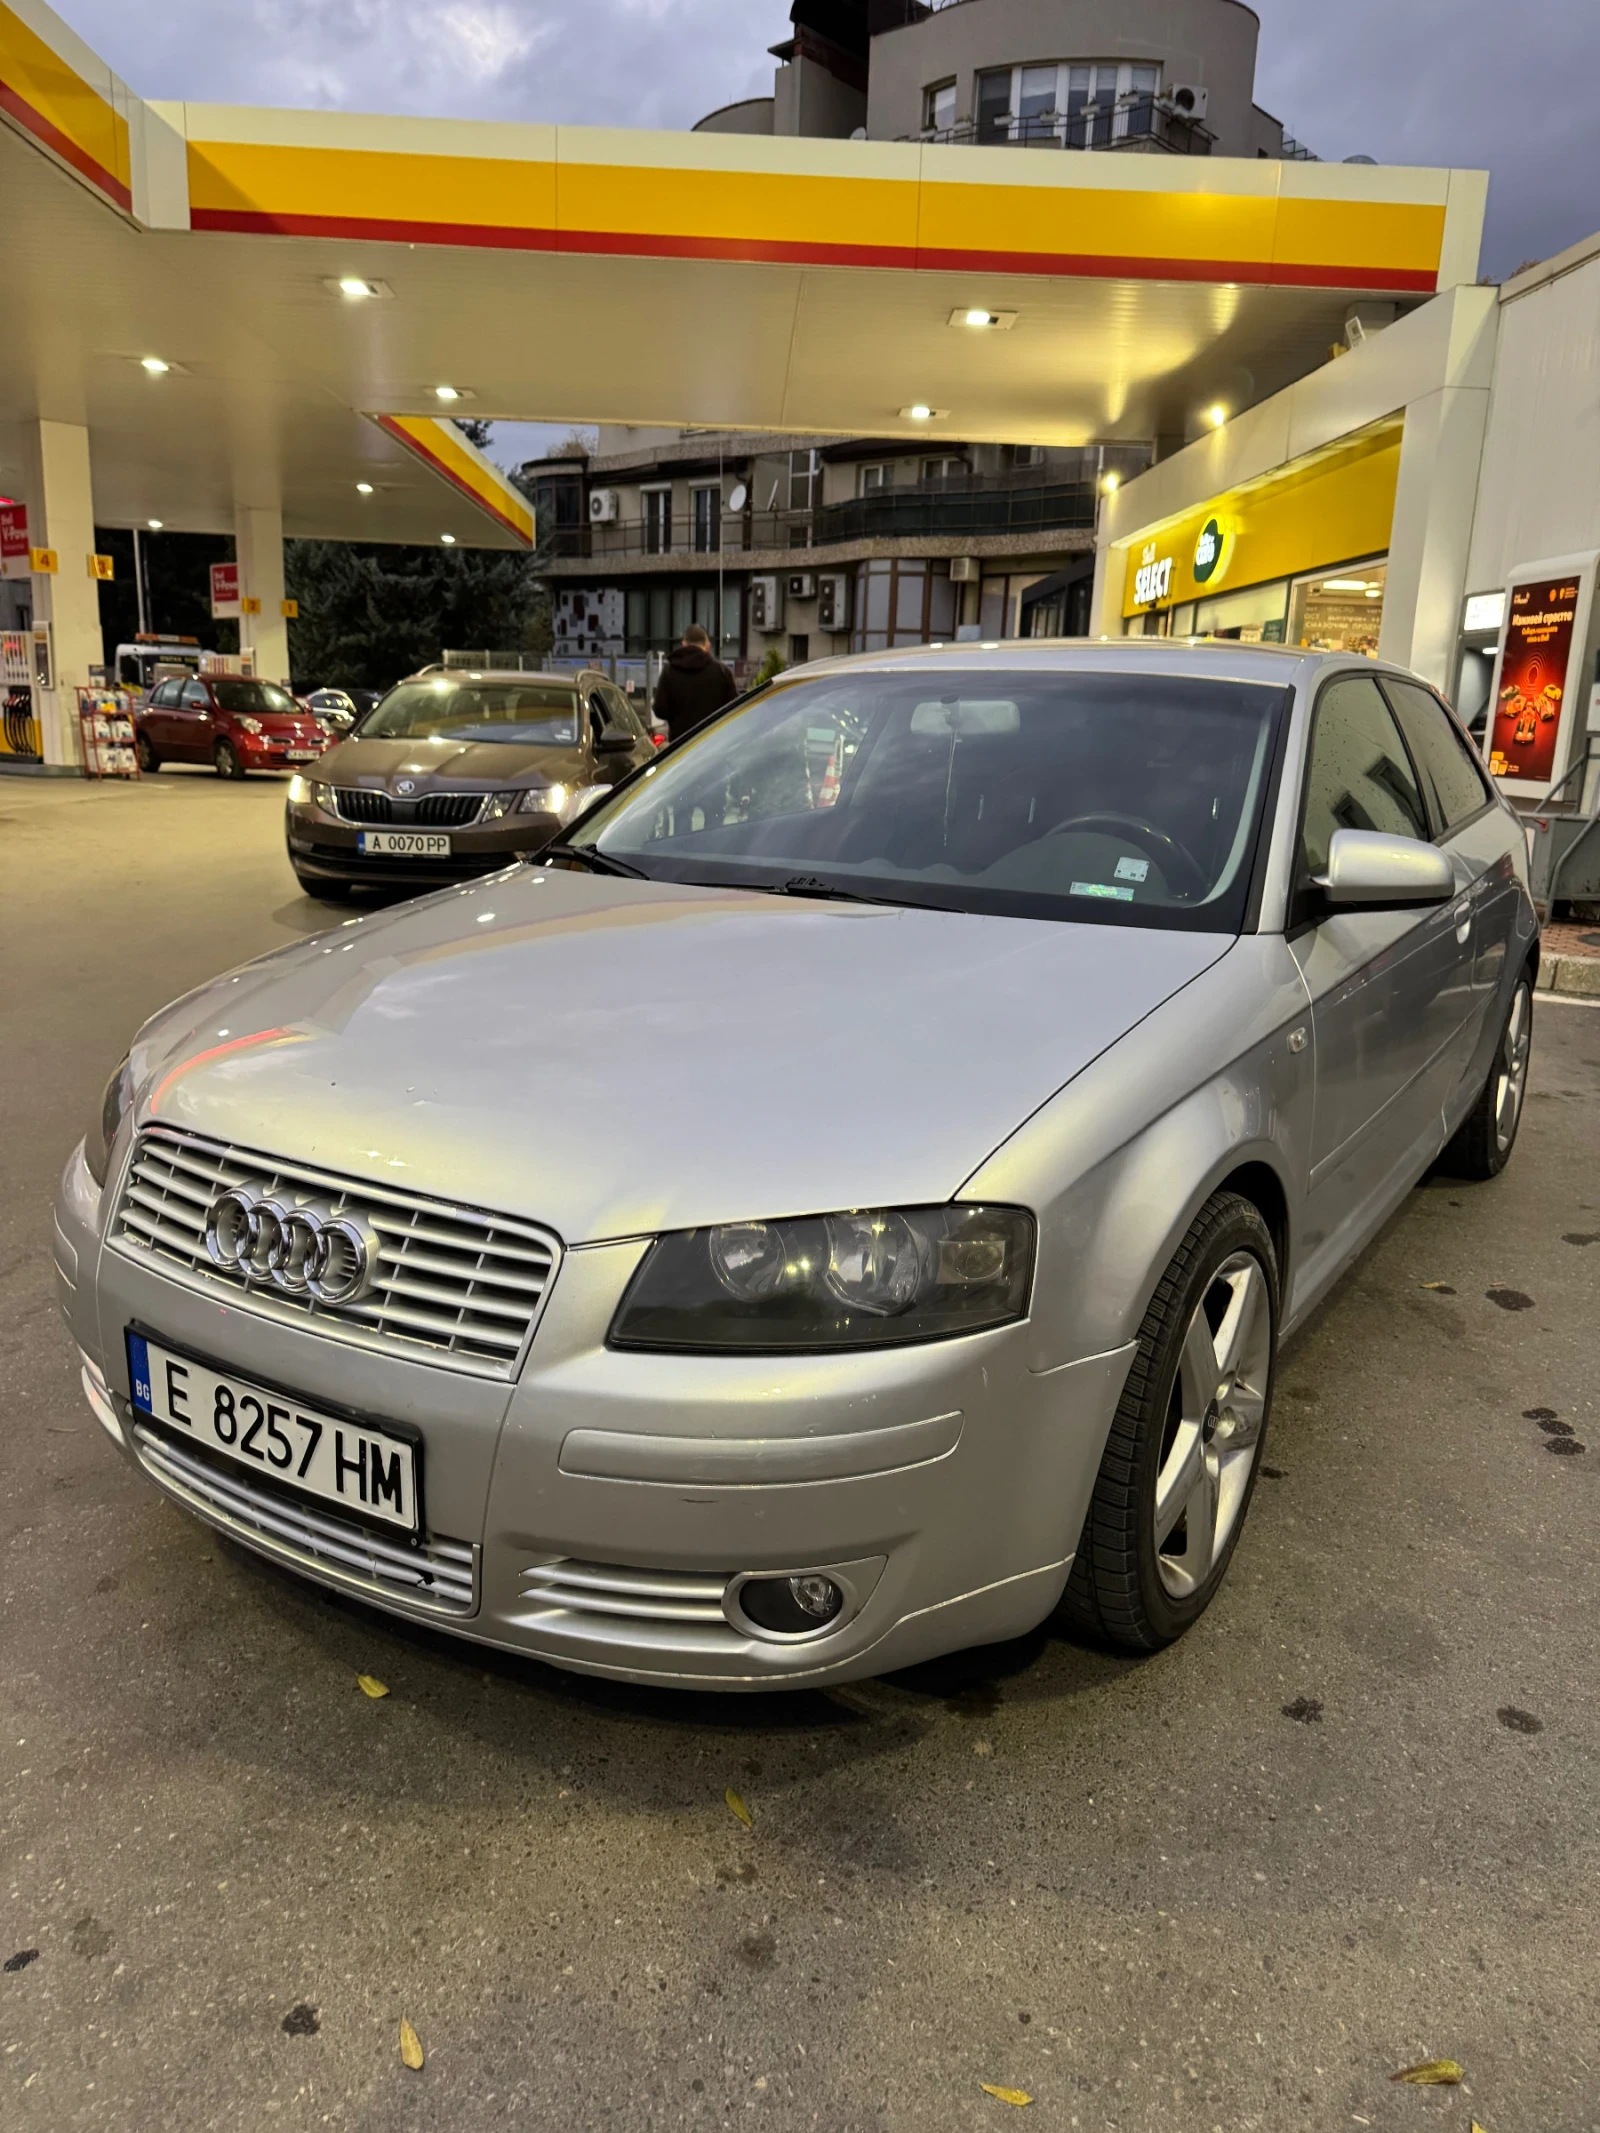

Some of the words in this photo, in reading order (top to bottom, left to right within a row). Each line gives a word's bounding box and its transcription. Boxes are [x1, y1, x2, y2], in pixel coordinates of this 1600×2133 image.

[40, 554, 50, 567] 4
[1134, 557, 1172, 604] SELECT
[372, 835, 382, 850] A
[388, 836, 424, 851] 0070
[426, 837, 447, 852] PP
[135, 1378, 150, 1402] BG
[166, 1359, 192, 1427] E
[213, 1384, 323, 1478] 8257
[335, 1429, 403, 1515] HM
